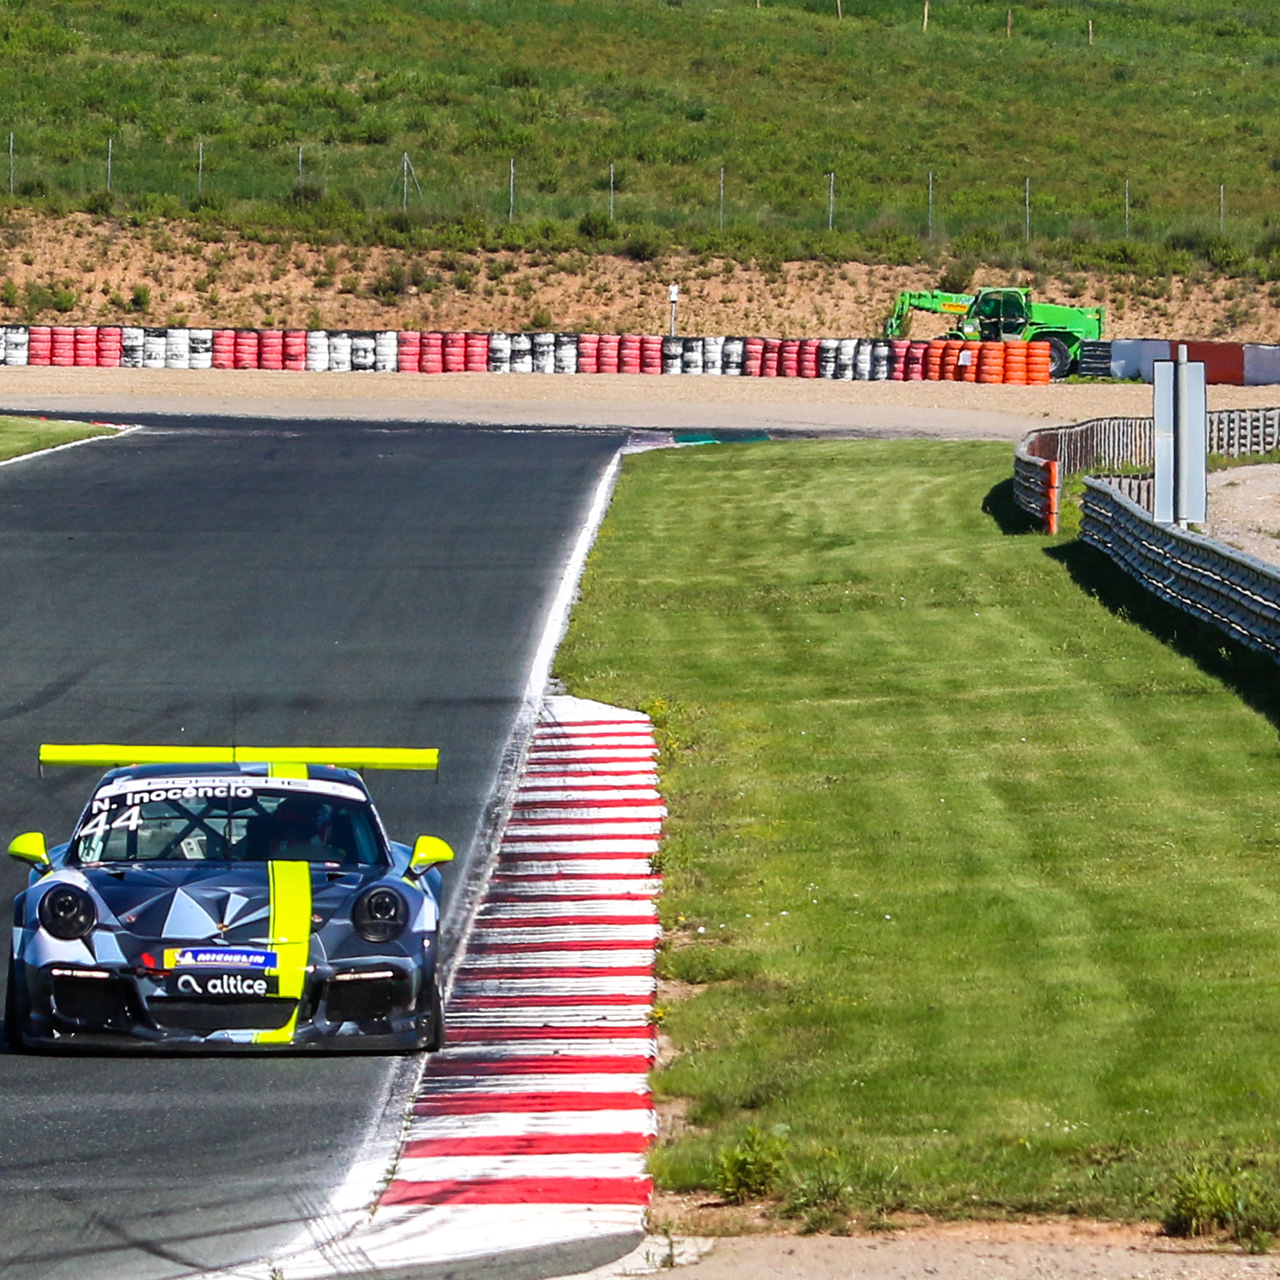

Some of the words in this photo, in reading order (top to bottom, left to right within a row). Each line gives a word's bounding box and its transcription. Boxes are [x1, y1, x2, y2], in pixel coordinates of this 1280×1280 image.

[92, 798, 117, 814] N.
[80, 806, 143, 837] 44
[197, 953, 265, 963] MICHELIN
[207, 975, 267, 994] altice
